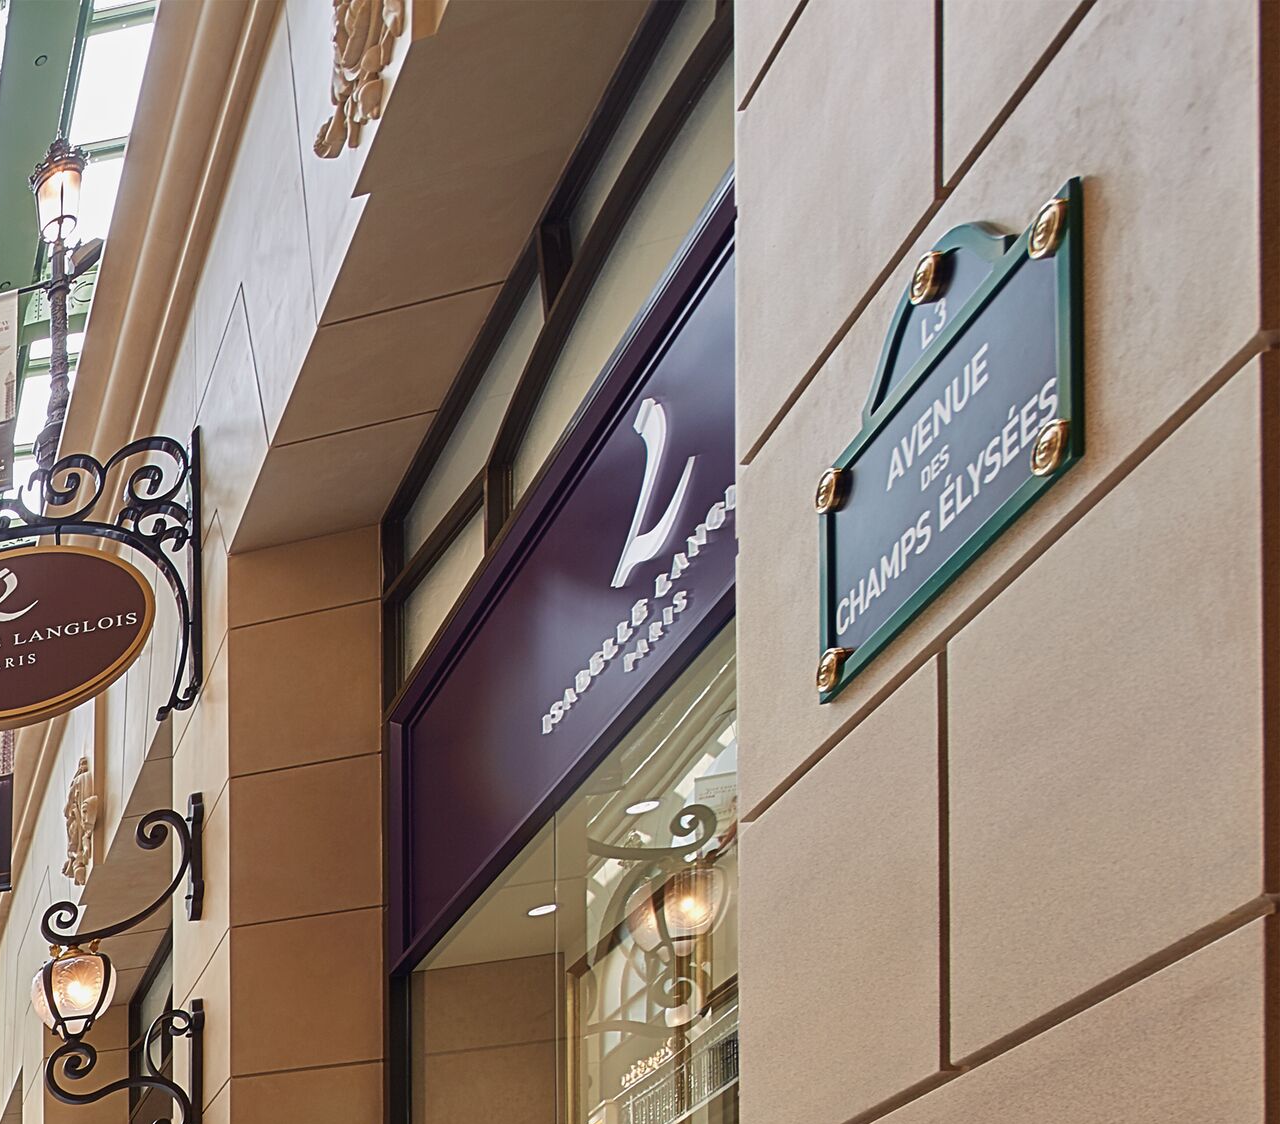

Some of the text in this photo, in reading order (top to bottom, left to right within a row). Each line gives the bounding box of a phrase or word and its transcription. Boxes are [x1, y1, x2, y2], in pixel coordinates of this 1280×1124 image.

[921, 298, 947, 350] L3
[886, 342, 989, 491] AVENUE
[920, 444, 950, 492] DES
[836, 378, 1058, 636] CHAMPS ÉLYSÉES
[13, 612, 138, 646] LANGLOIS
